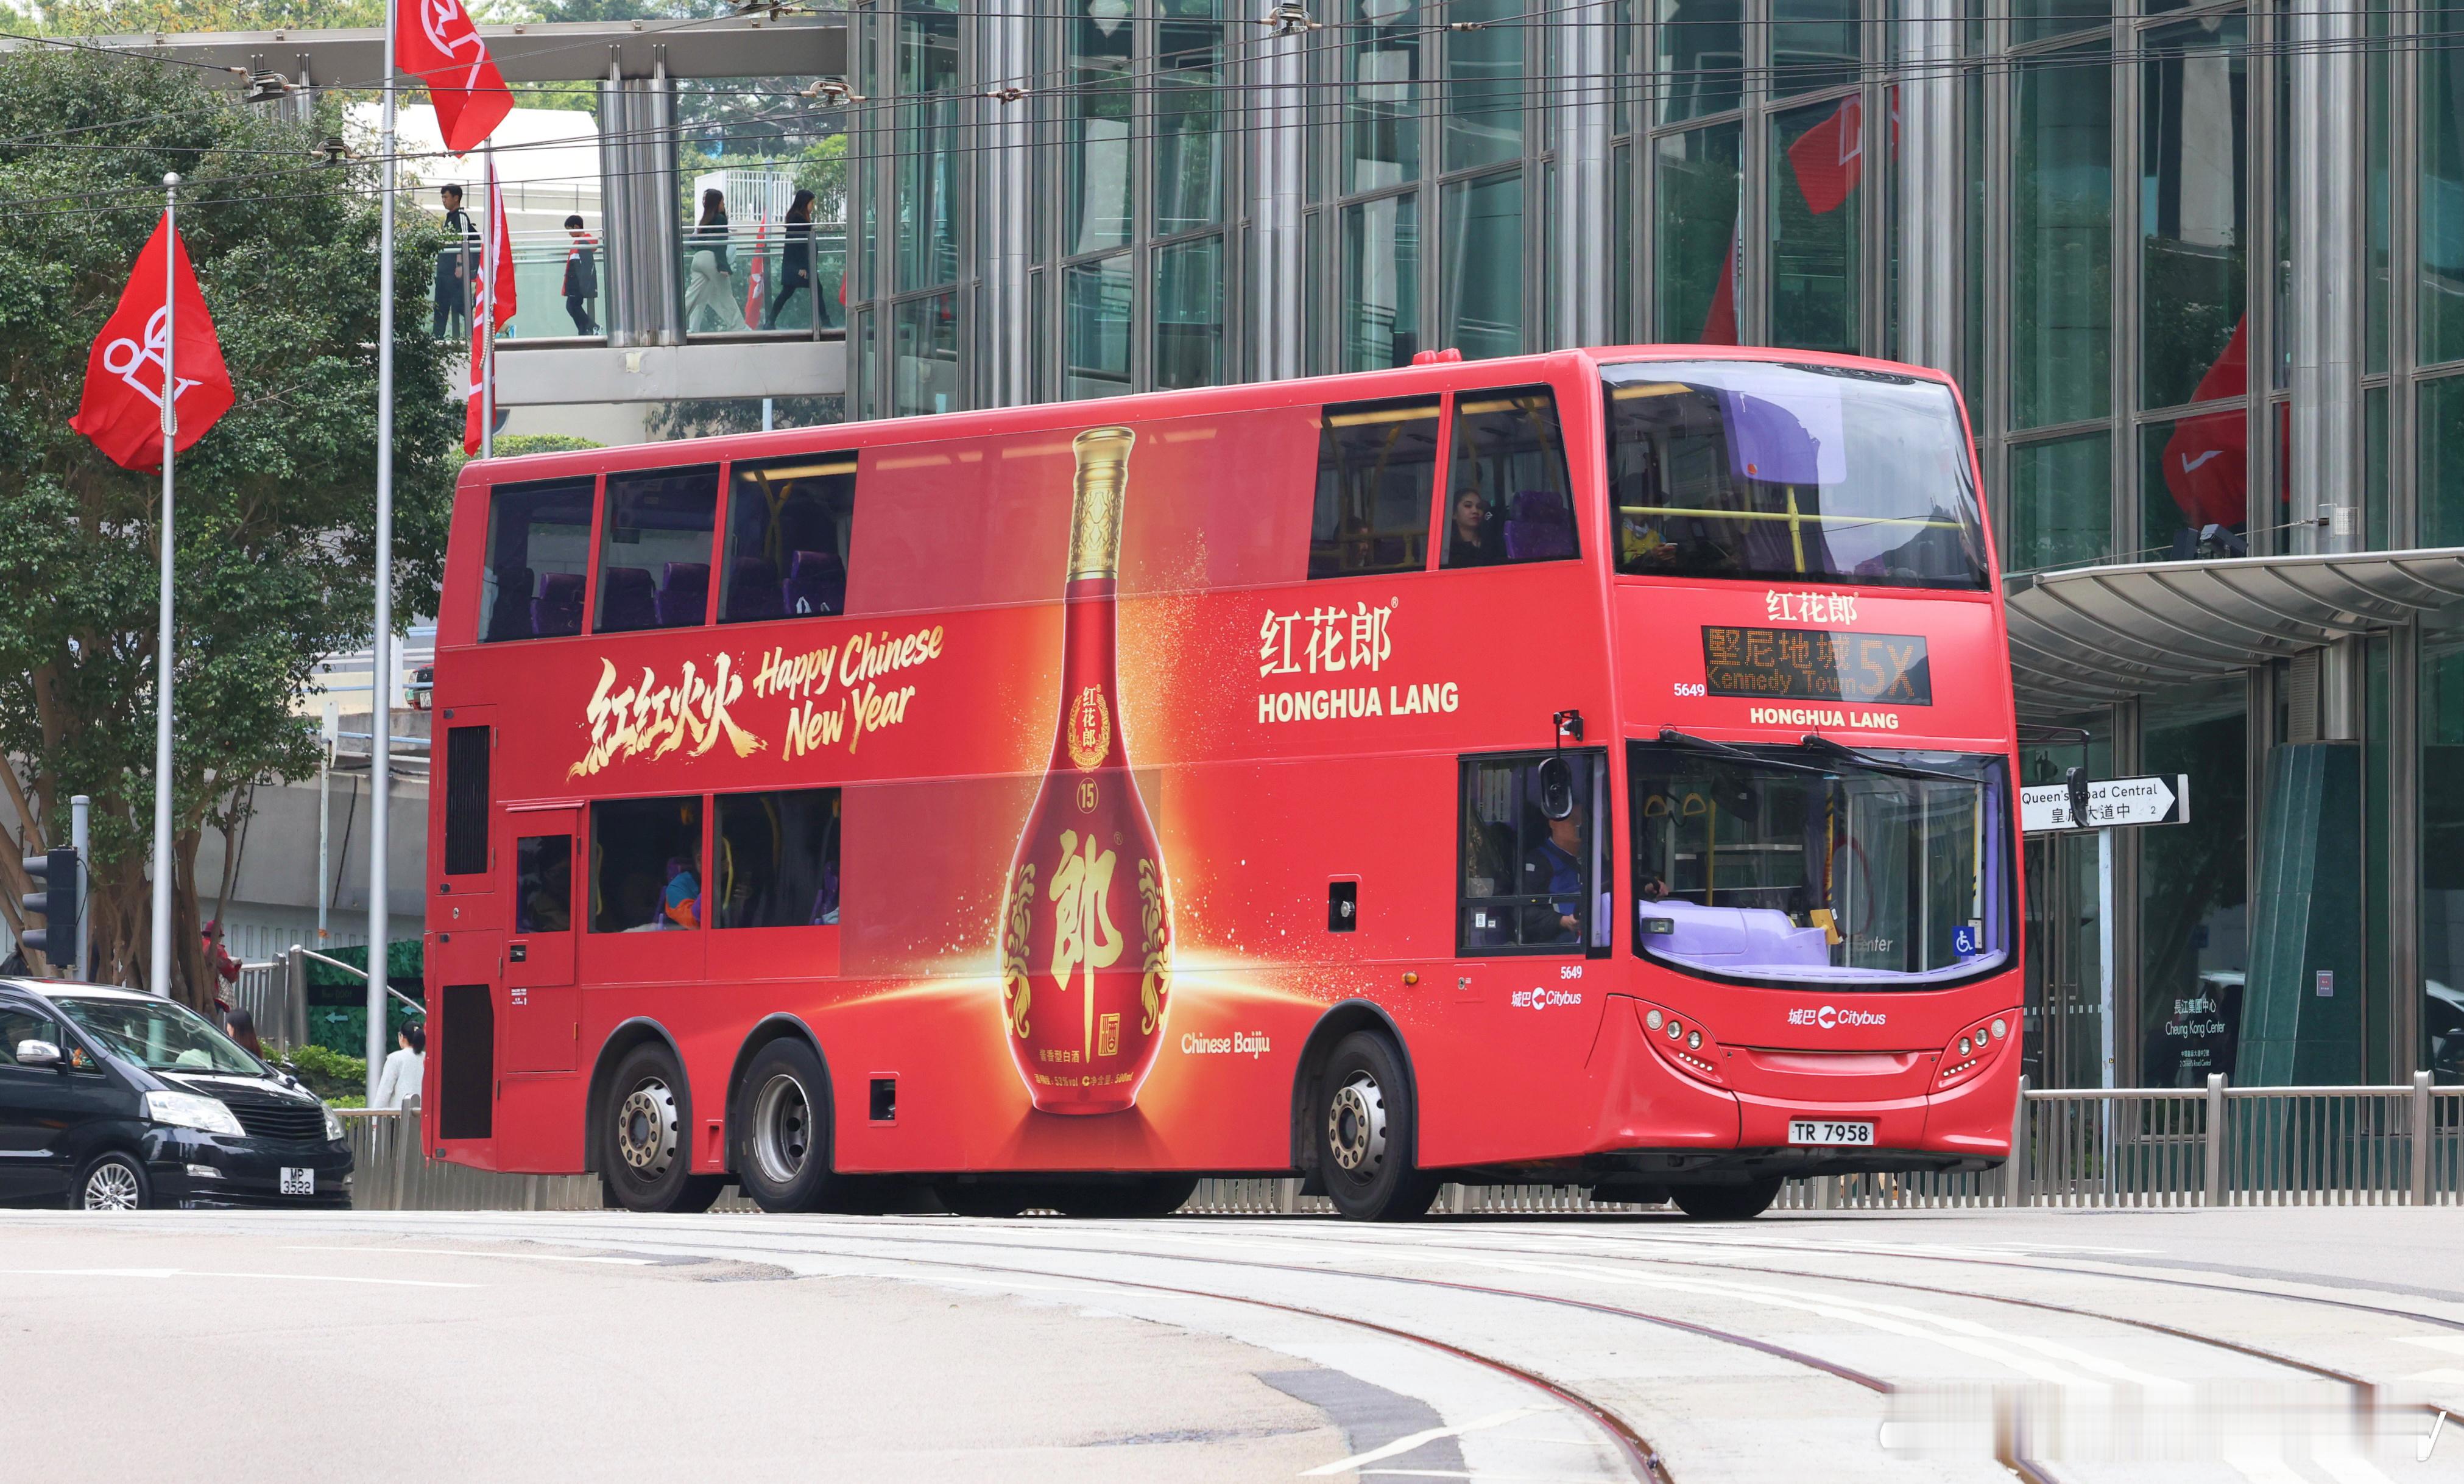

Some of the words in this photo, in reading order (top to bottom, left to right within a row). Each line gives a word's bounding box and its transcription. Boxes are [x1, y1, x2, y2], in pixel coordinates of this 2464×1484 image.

[1766, 589, 1859, 625] 红花郎
[1259, 601, 1393, 679] 红花郎
[753, 645, 838, 700] Happy
[839, 625, 944, 687] Chinese
[1709, 628, 1851, 670] 堅尼地城
[1859, 639, 1914, 697] 5X
[1674, 683, 1706, 697] 5649
[1706, 666, 1793, 695] Kennedy
[1802, 669, 1856, 695] Town
[1258, 687, 1383, 724] HONGHUA
[1390, 681, 1459, 716] LANG
[782, 699, 846, 762] New
[847, 682, 916, 754] Year
[1082, 686, 1096, 748] 红花郎
[1749, 708, 1844, 726] HONGHUA
[1850, 713, 1899, 730] LANG
[1081, 783, 1095, 809] 15
[2022, 790, 2069, 804] Queen's
[2111, 784, 2158, 798] Central
[2150, 806, 2156, 815] 2
[1048, 828, 1124, 1064] 郎
[1561, 965, 1582, 979] 5649
[1511, 991, 1531, 1007] 城巴
[1545, 990, 1581, 1007] Citybus
[2174, 999, 2216, 1015] 長江集團中心
[1787, 1008, 1816, 1025] 城巴
[1837, 1009, 1887, 1027] Citybus
[2166, 1020, 2188, 1039] Cheung
[2189, 1020, 2205, 1038] Kong
[2206, 1019, 2225, 1033] Center
[1181, 1032, 1231, 1054] Chinese
[1234, 1030, 1271, 1060] Baijiu
[1795, 1124, 1816, 1141] TR
[1824, 1124, 1869, 1142] 7958
[283, 1181, 311, 1194] 3522
